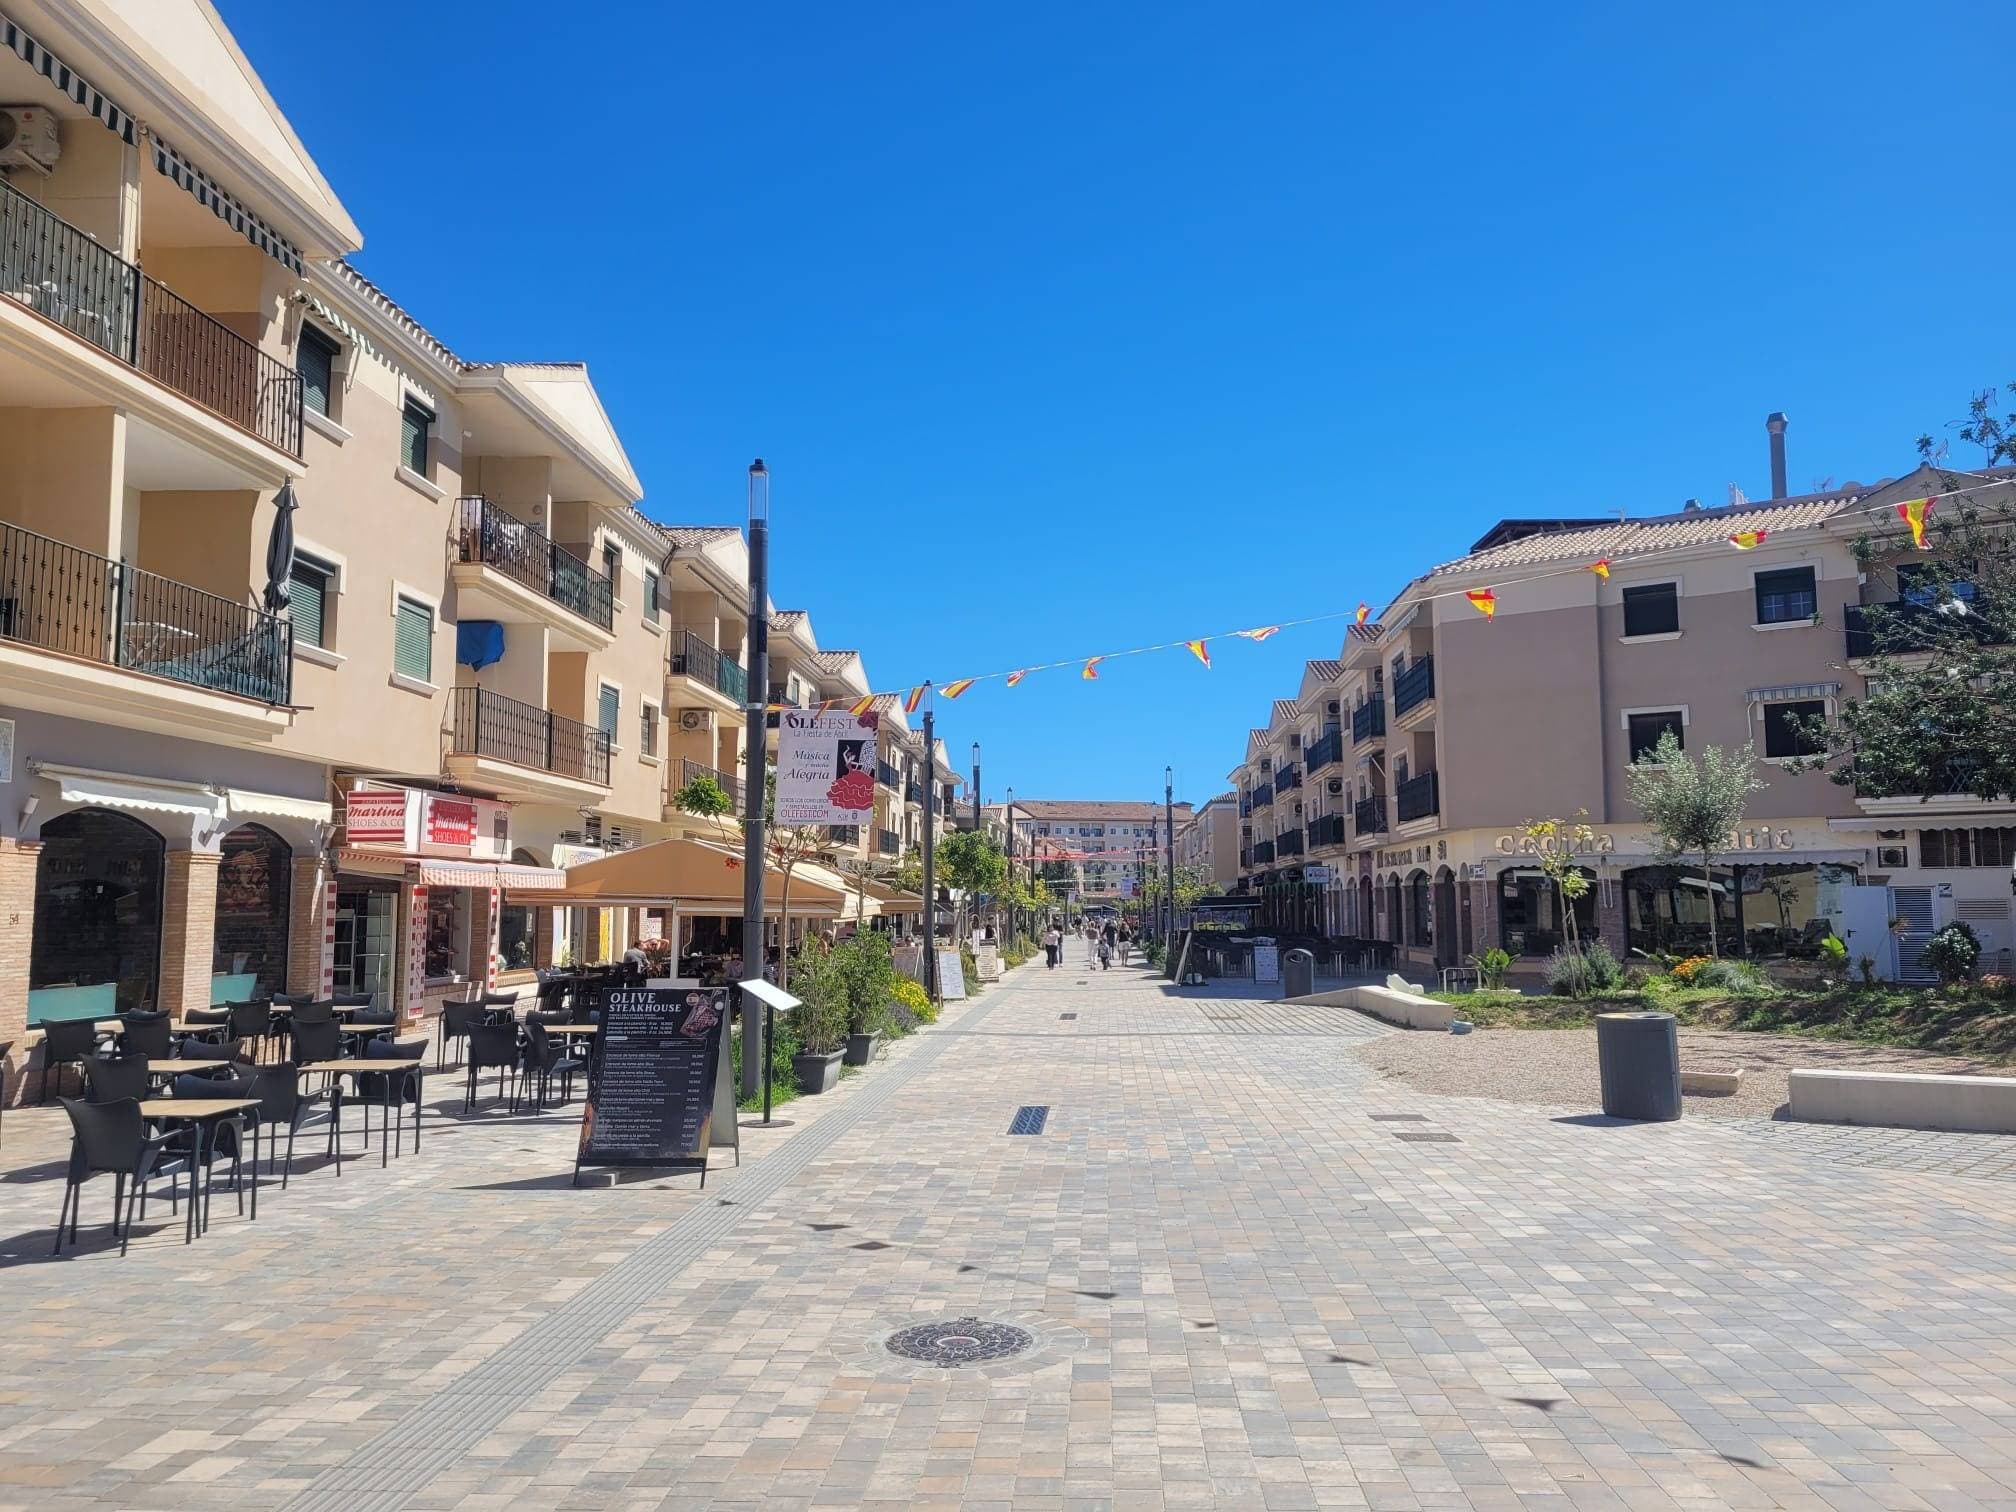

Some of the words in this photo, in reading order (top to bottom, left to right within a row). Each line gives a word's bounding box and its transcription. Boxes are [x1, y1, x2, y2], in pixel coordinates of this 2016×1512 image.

[348, 819, 377, 827] SHOES
[380, 819, 387, 827] &
[434, 831, 453, 843] SHOES
[610, 992, 656, 1004] OLIVE
[608, 1003, 682, 1013] STEAKHOUSE
